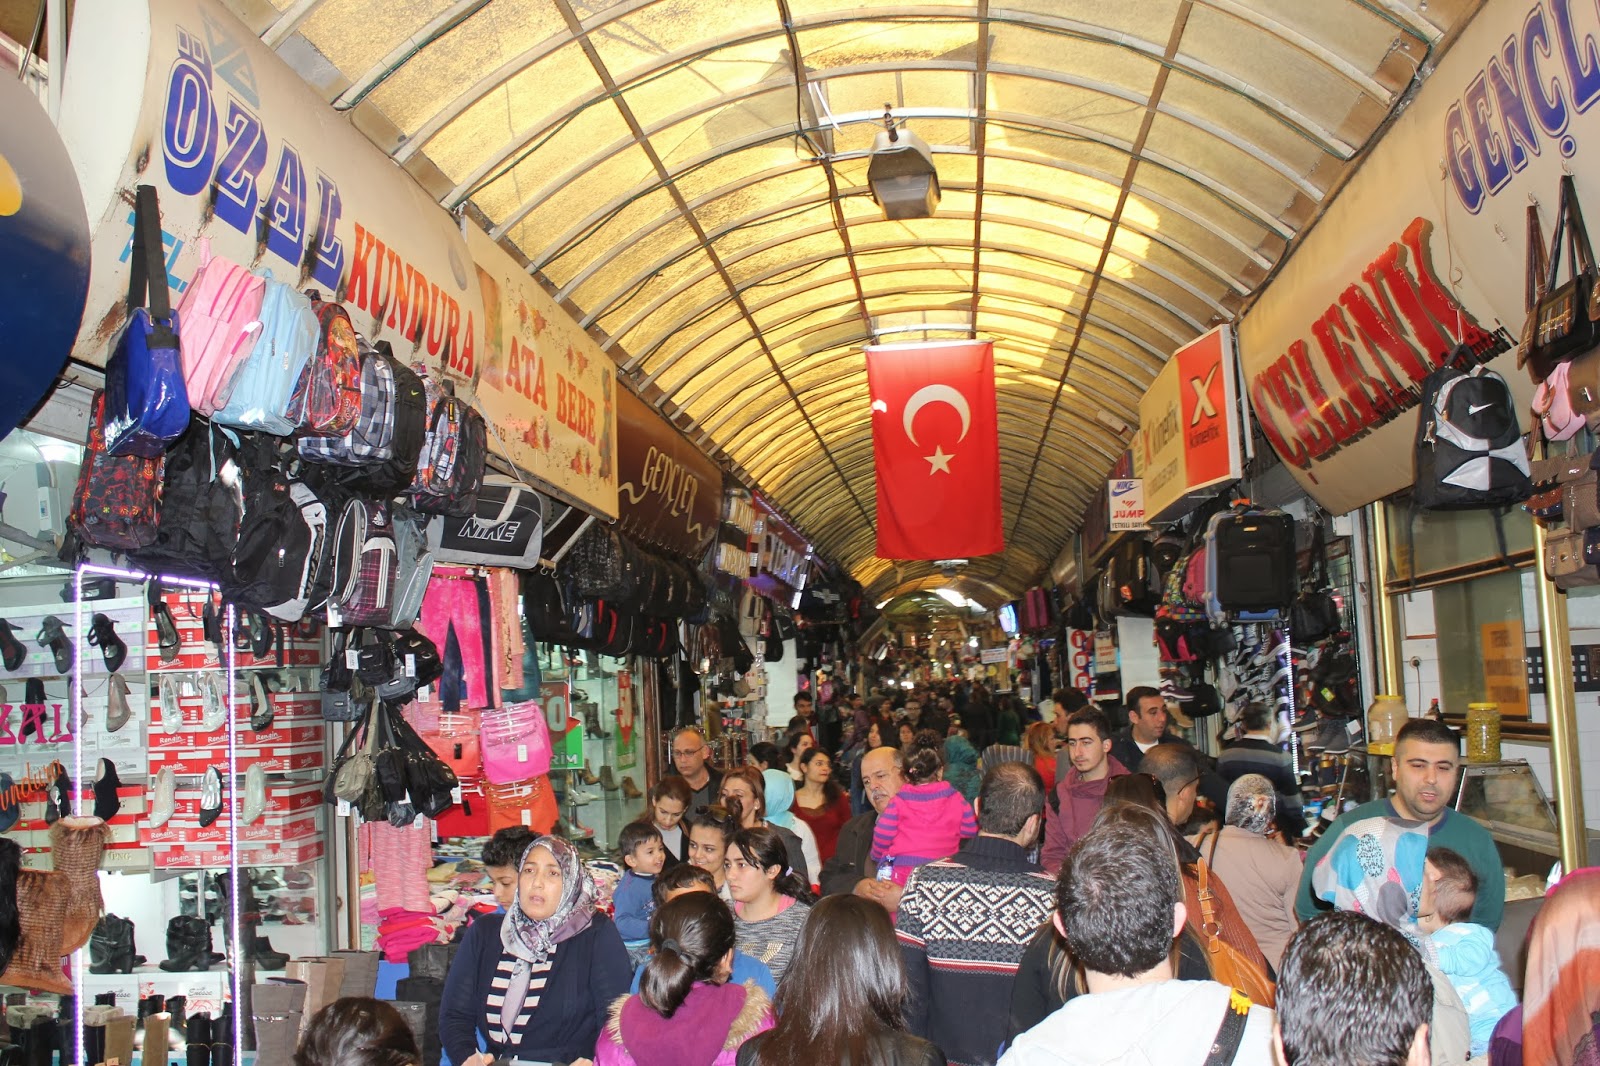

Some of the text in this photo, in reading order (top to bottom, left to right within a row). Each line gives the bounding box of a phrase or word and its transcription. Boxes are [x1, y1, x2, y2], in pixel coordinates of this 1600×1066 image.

[162, 24, 475, 378] ÖZAL KUNDURA
[506, 335, 596, 447] ATA BEBE
[1115, 480, 1135, 490] NIKE
[1113, 509, 1145, 519] JUMP
[458, 517, 521, 543] NIKE
[159, 735, 182, 744] Rengin
[256, 731, 279, 741] Rengin
[151, 830, 174, 840] Rengin
[197, 829, 220, 839] Rengin
[166, 853, 189, 863] Rengin
